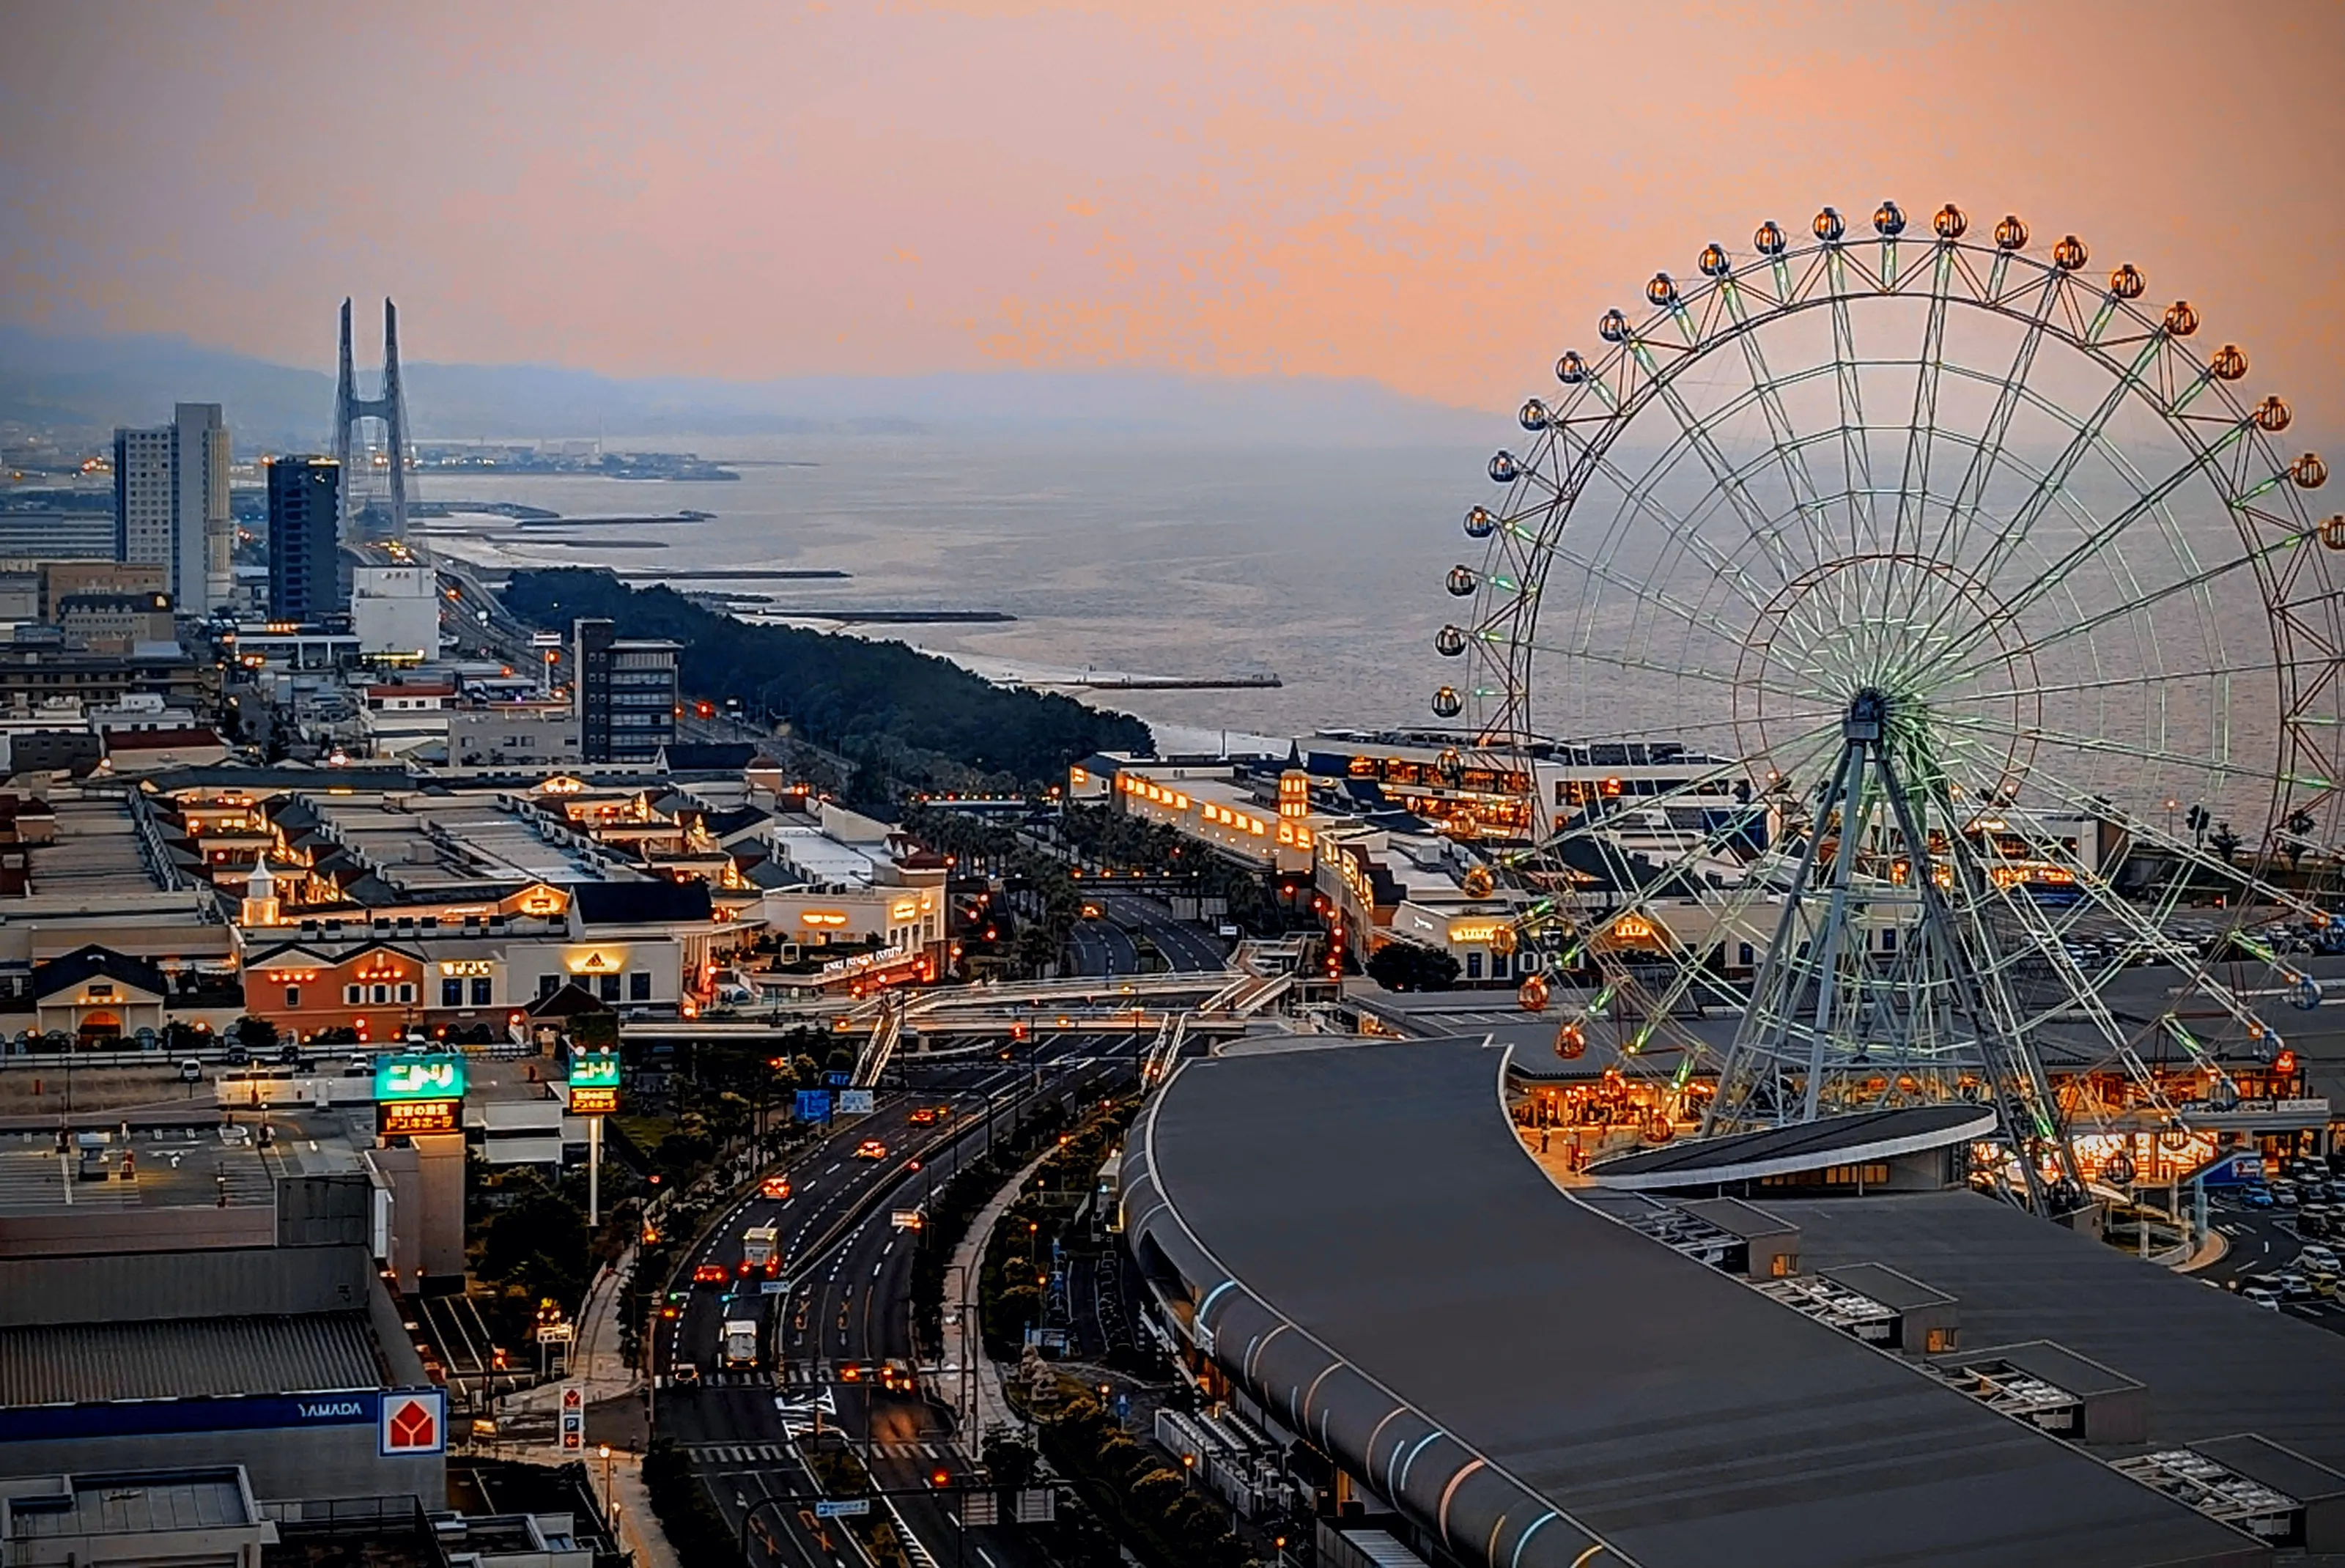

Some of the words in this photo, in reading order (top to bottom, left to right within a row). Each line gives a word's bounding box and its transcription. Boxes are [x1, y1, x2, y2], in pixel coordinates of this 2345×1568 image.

[387, 1063, 454, 1091] ニトリ
[572, 1061, 616, 1079] ニトリ
[297, 1402, 363, 1417] YAMADA
[566, 1419, 577, 1430] P
